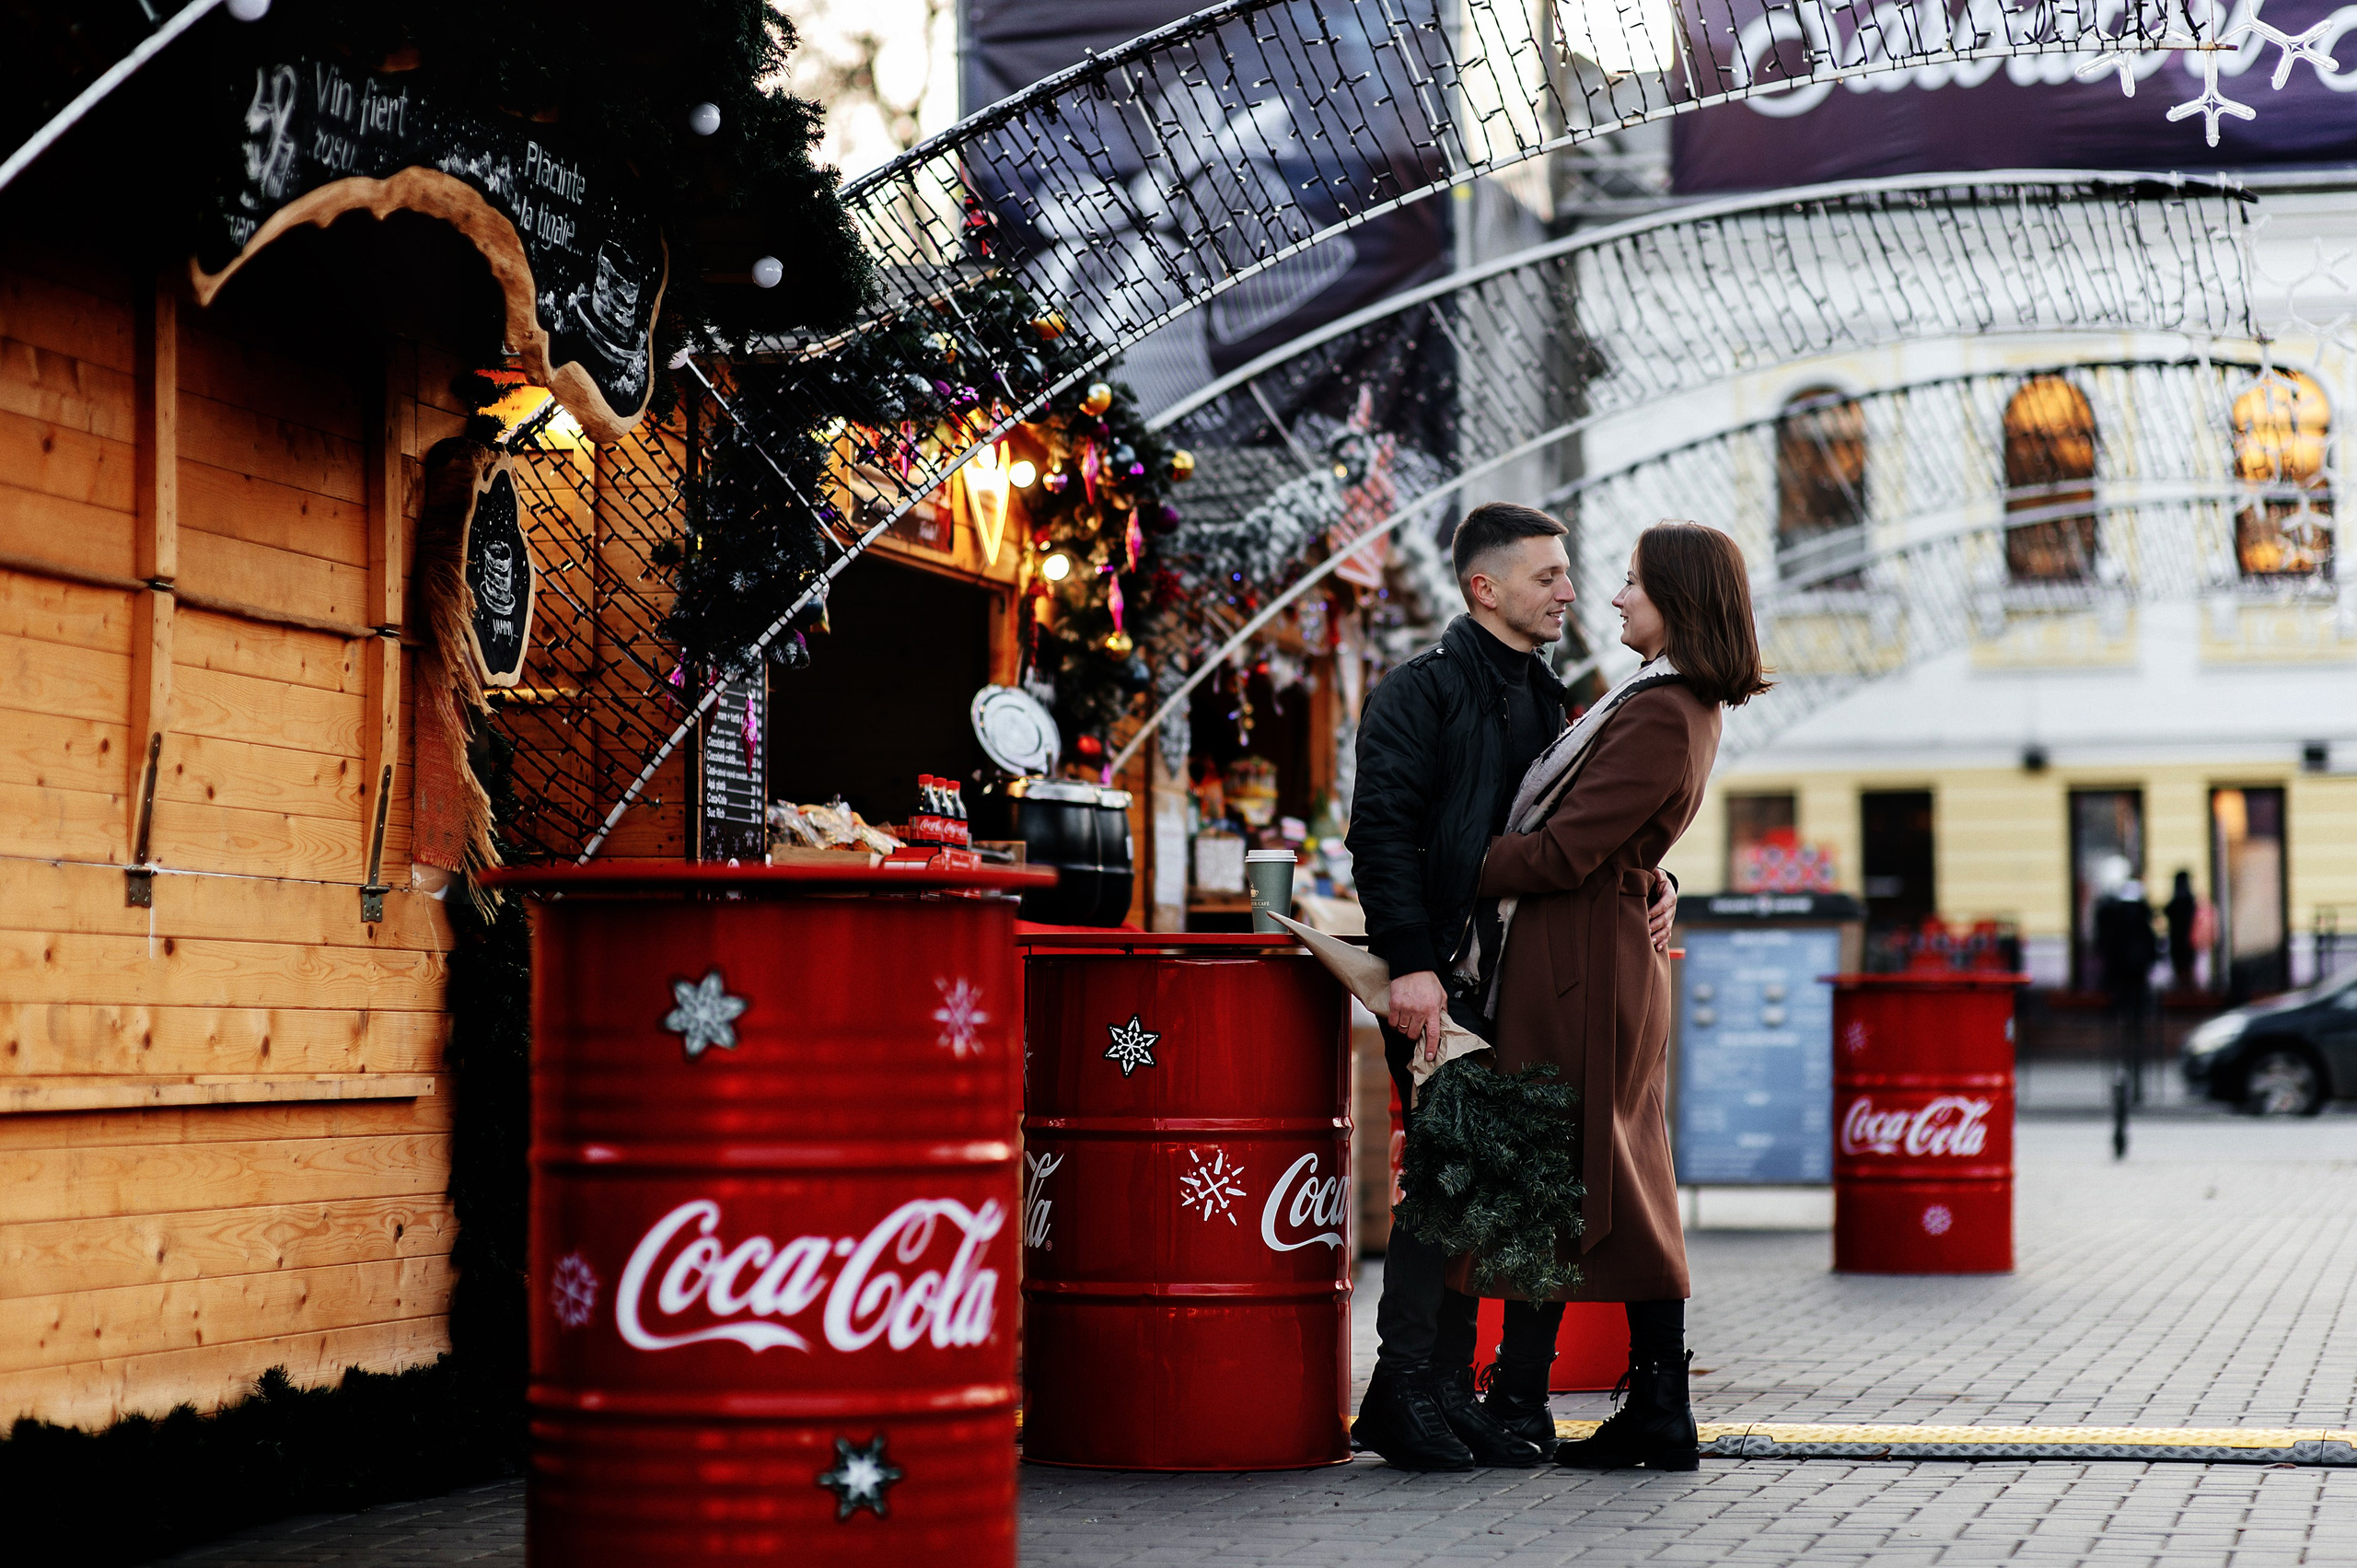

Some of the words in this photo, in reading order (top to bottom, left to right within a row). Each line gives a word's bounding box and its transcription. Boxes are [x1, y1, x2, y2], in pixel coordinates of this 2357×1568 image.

[315, 60, 353, 122] Vin
[359, 76, 408, 137] fiert
[519, 195, 533, 231] la
[1840, 1095, 1994, 1157] Coca-Cola
[615, 1198, 1008, 1355] Coca-Cola
